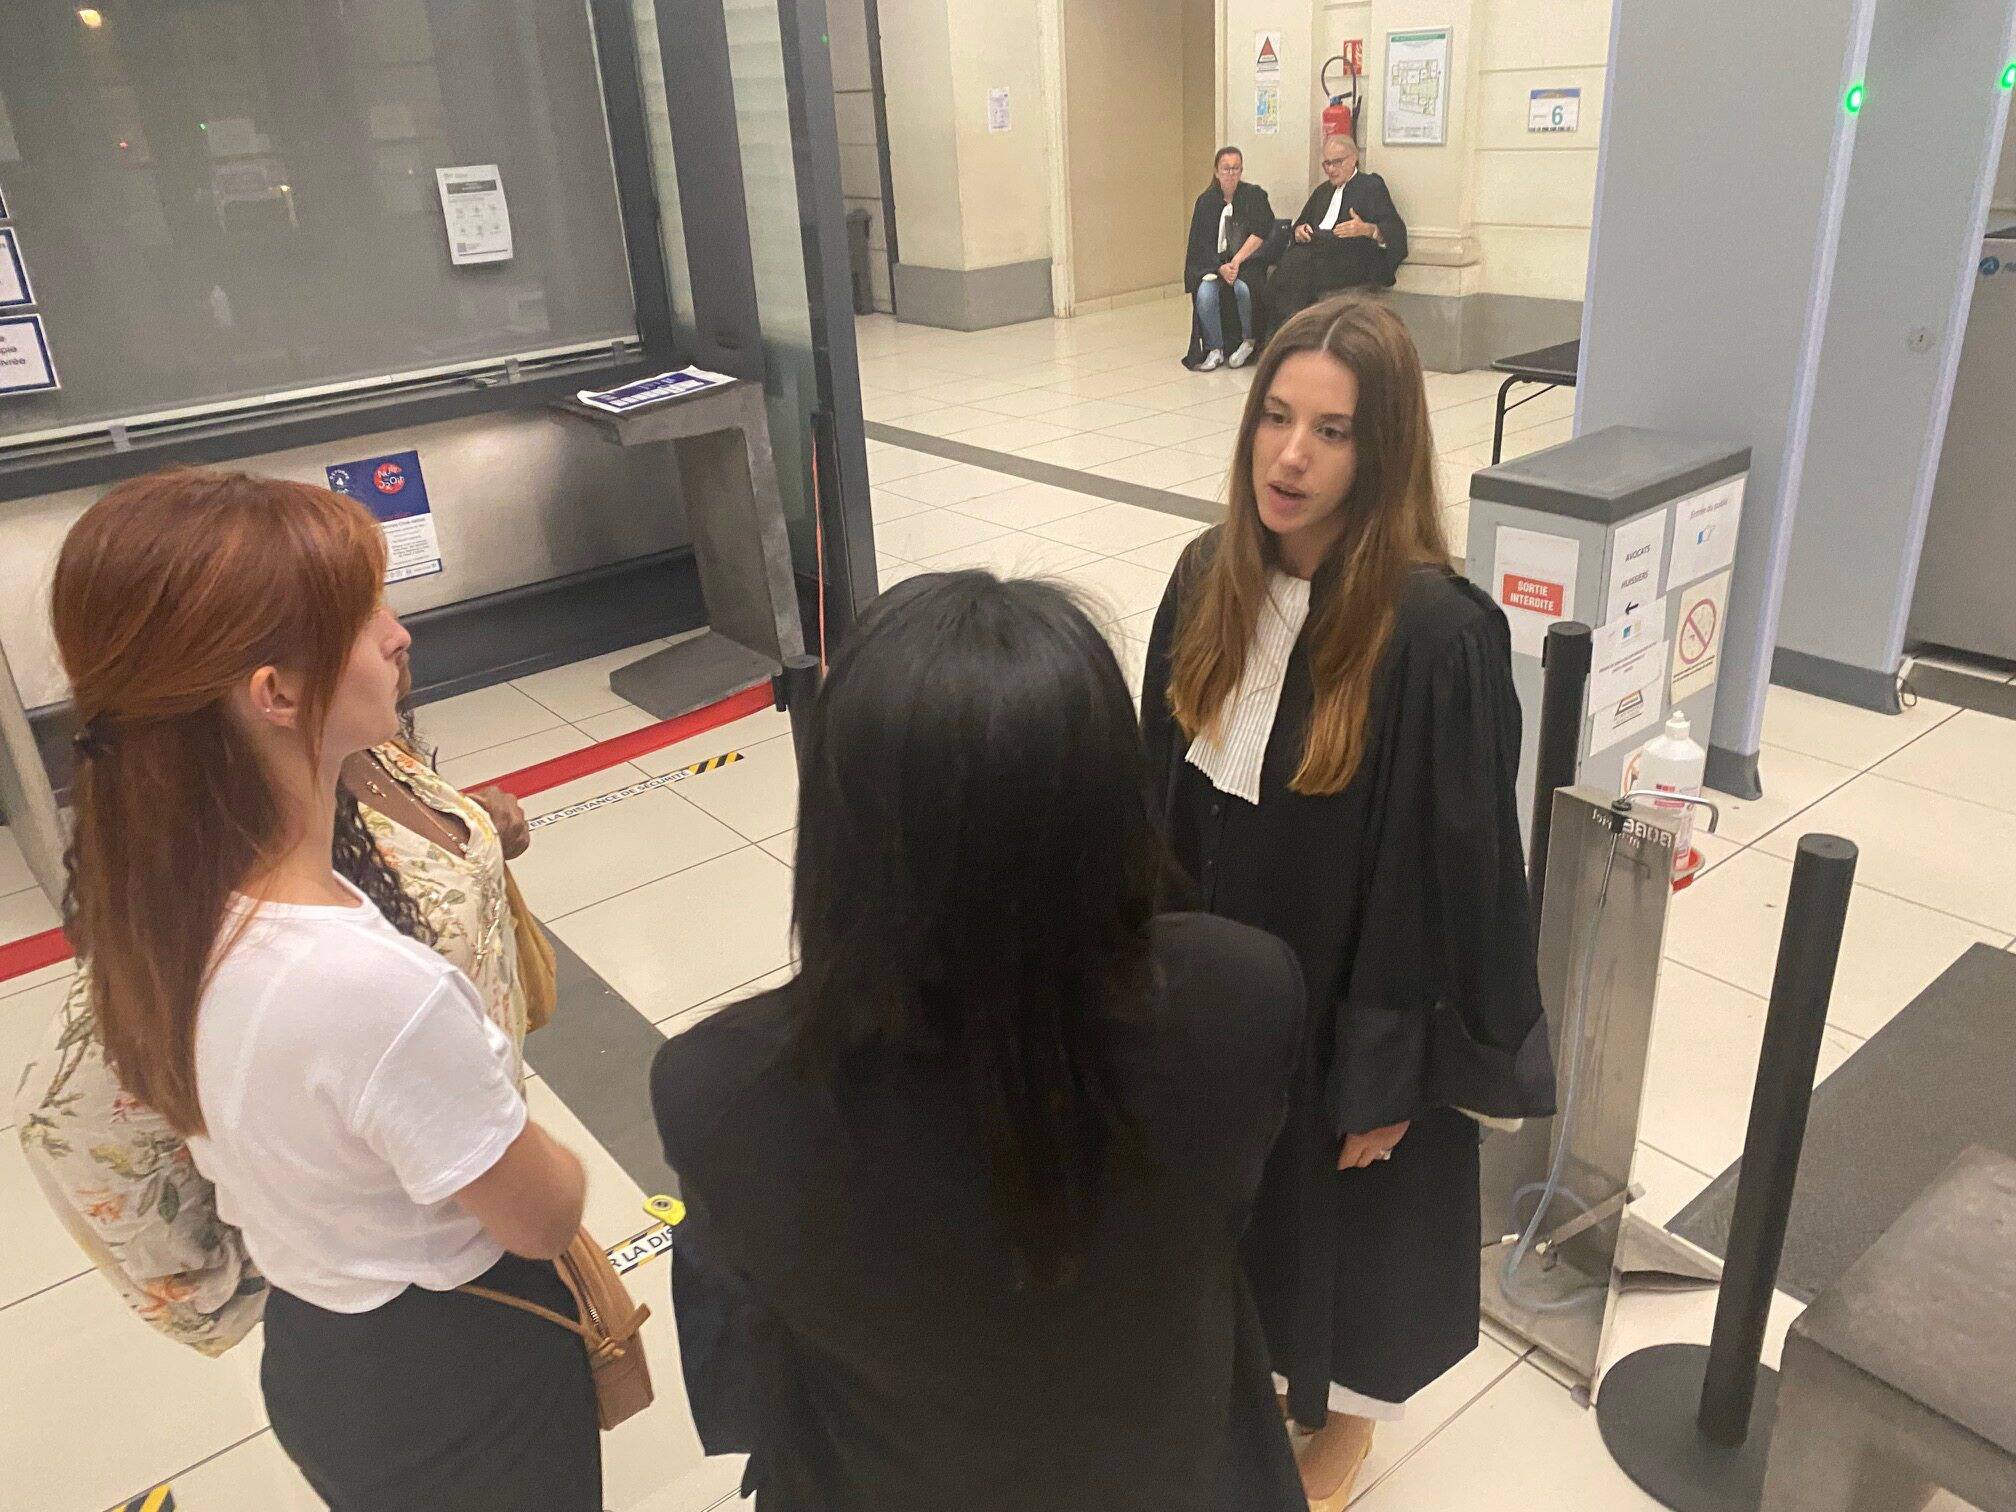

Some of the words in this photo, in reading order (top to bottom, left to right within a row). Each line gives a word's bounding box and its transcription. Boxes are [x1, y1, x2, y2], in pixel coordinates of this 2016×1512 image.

[1551, 105, 1563, 125] 6
[1625, 544, 1650, 561] AVOCATS
[1517, 580, 1548, 596] SORTIE
[1509, 592, 1554, 611] INTERDITE
[530, 818, 547, 827] ER
[547, 812, 564, 821] LA
[564, 794, 619, 816] DISTANCE
[620, 787, 638, 796] DE
[621, 1245, 648, 1262] LA
